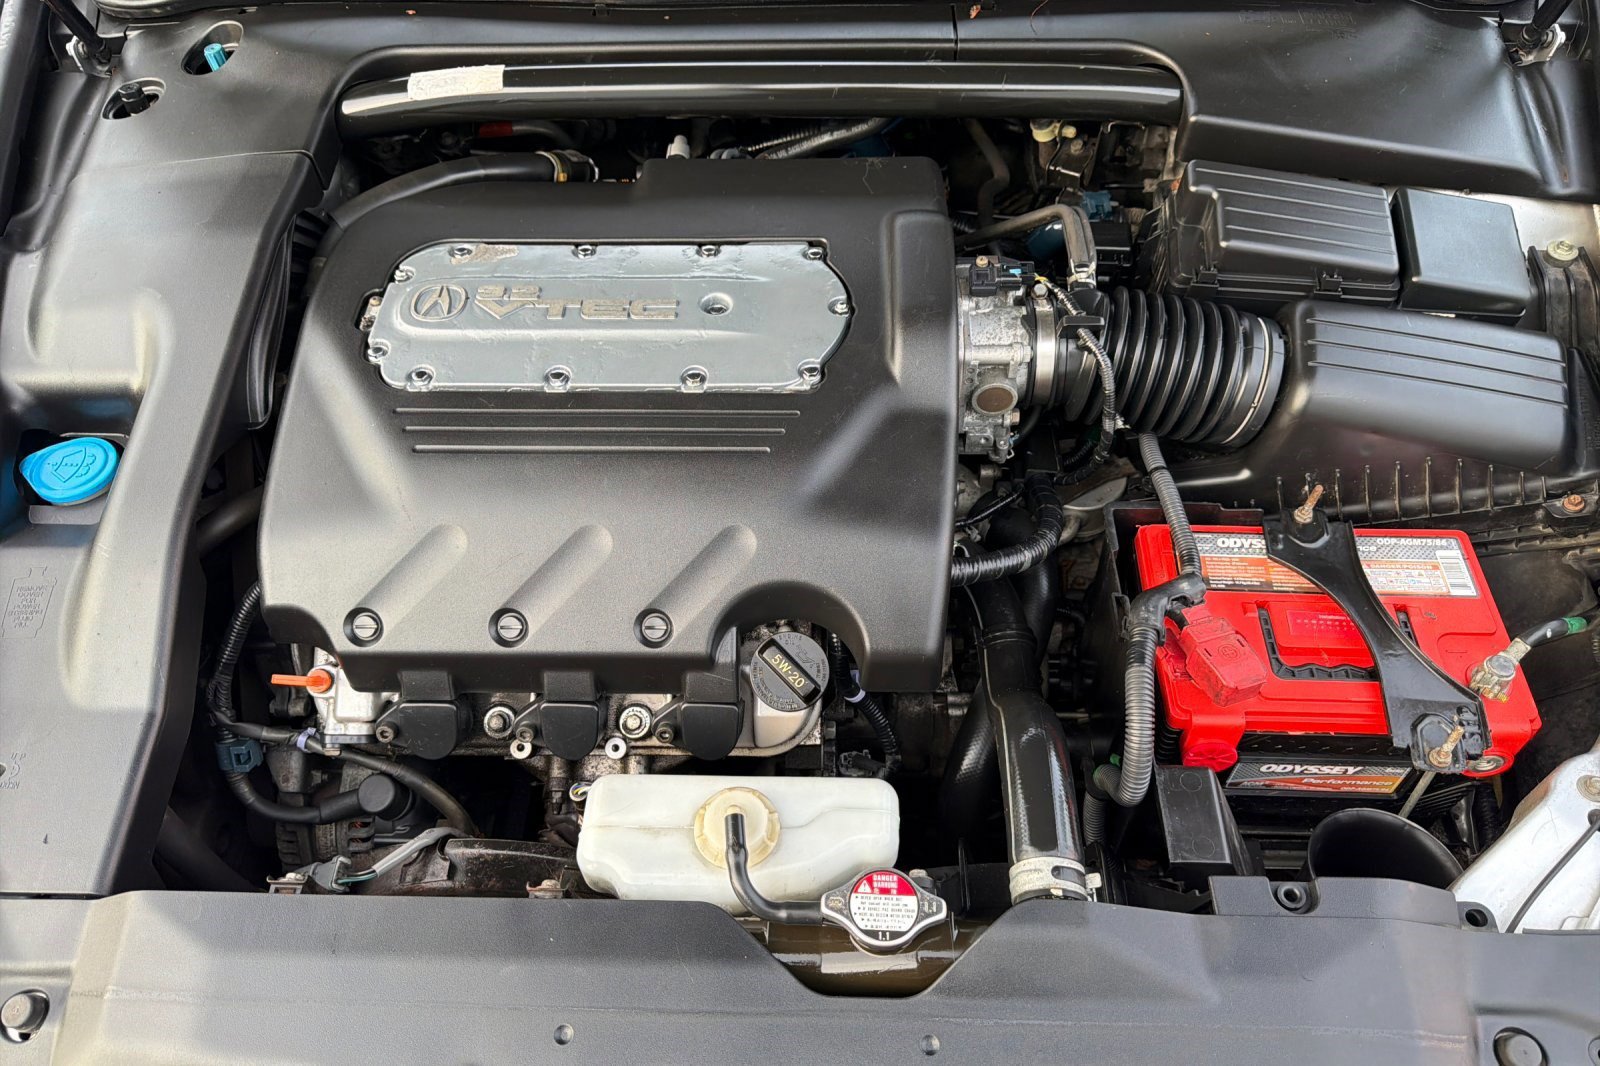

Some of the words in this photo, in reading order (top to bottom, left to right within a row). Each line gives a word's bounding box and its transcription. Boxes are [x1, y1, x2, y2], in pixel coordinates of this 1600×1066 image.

[475, 285, 541, 300] 3.2
[474, 299, 679, 320] VTEC
[771, 653, 805, 688] 5W-20
[1259, 763, 1364, 775] ODYSSEY
[1301, 777, 1393, 787] Performance
[878, 931, 890, 941] 1.1
